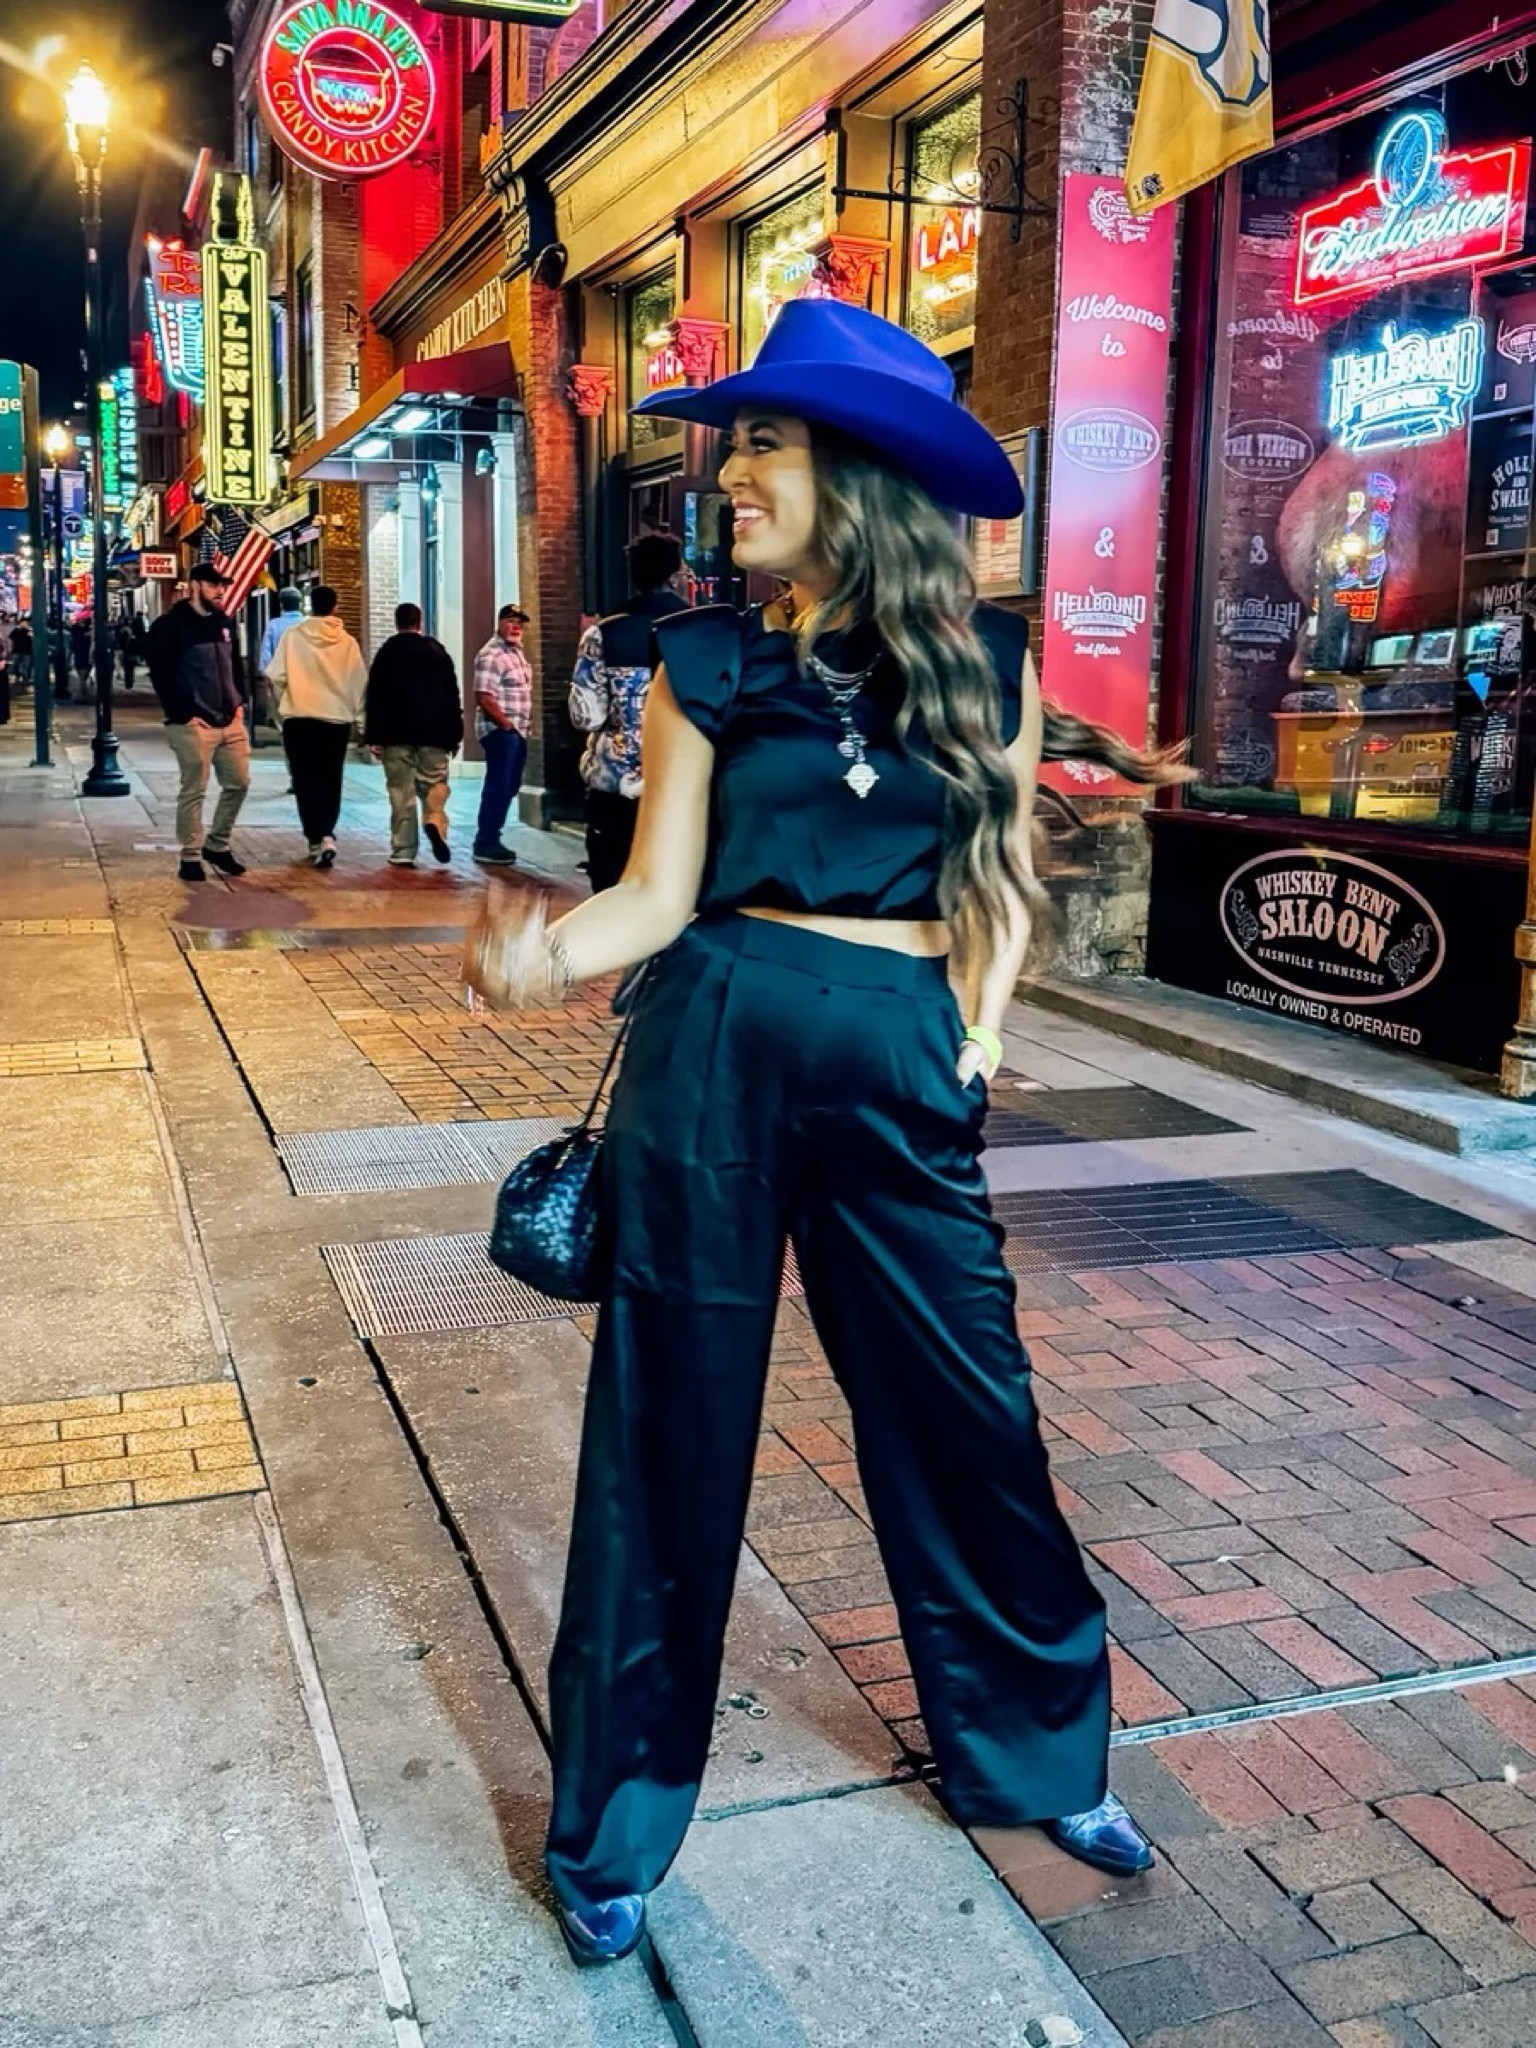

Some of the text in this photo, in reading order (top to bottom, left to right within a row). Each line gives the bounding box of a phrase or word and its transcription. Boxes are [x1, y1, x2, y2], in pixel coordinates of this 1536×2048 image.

[275, 0, 422, 69] SAVANNAH'S
[273, 82, 338, 155] CANDY
[345, 95, 425, 162] KITCHEN
[1305, 190, 1510, 279] Budweiser
[452, 276, 507, 352] KITCHEN
[1066, 294, 1166, 332] Welcome
[1101, 332, 1126, 357] to
[219, 262, 252, 498] VALENTINE
[0, 397, 21, 414] ge
[1067, 422, 1120, 448] WHISKEY
[1491, 455, 1532, 488] HOLL
[1094, 526, 1115, 558] &
[1053, 585, 1146, 623] HELLBOUND
[1255, 870, 1401, 925] WHISKEY BENT
[1258, 898, 1390, 965] SALOON
[1257, 947, 1385, 986] NASHVILLE TENNESSEE
[1226, 979, 1422, 1045] LOCALLY OWNED & OPERATED
